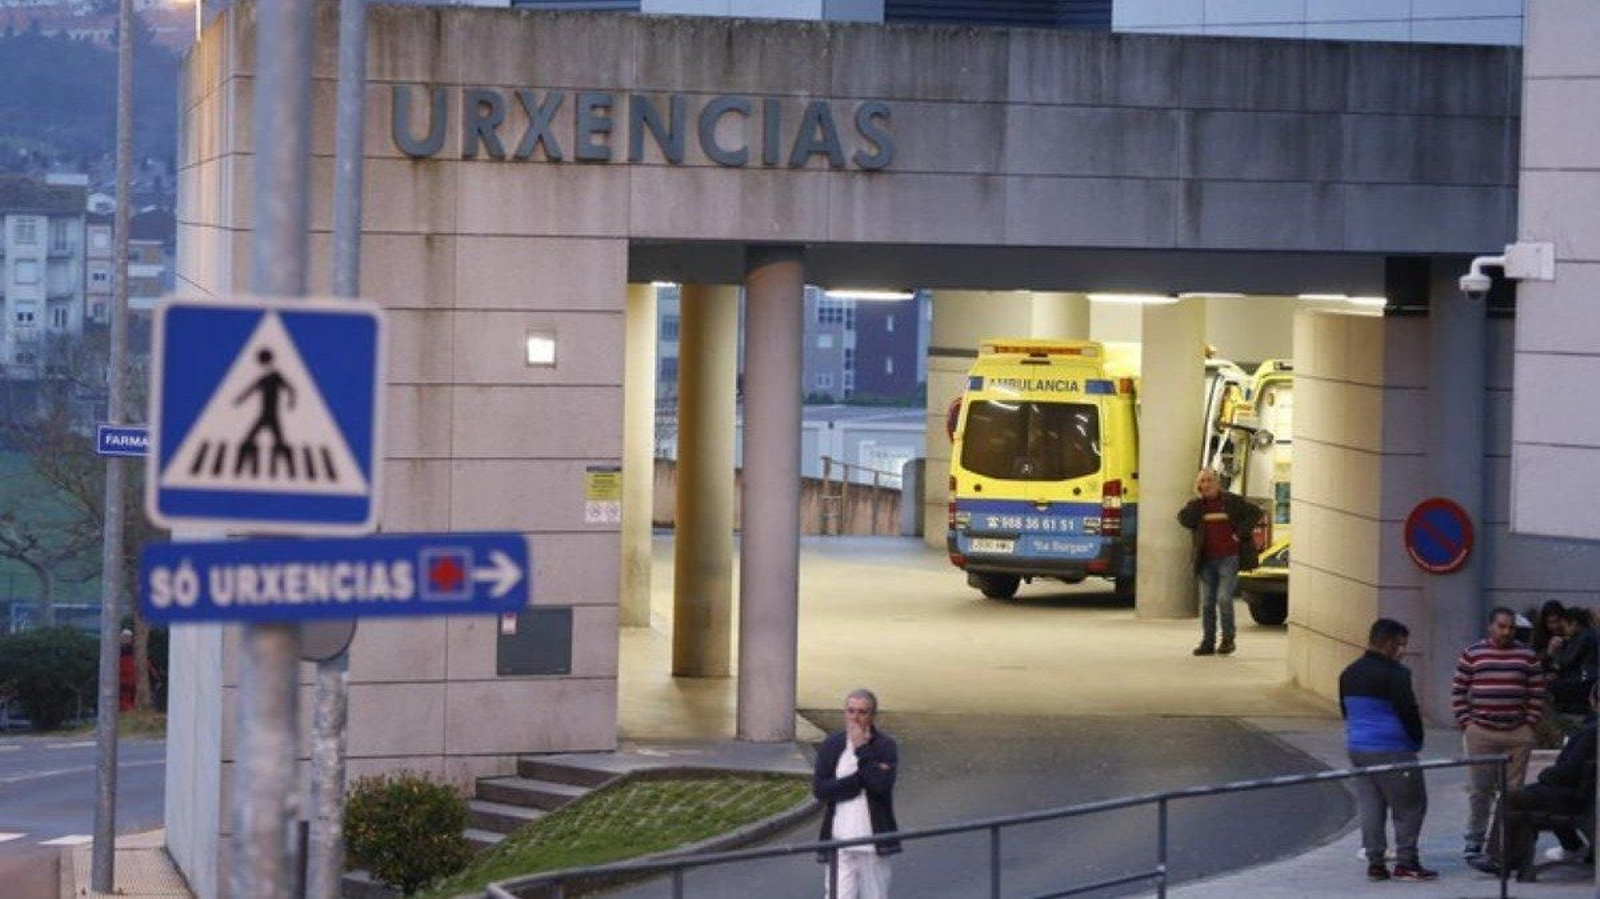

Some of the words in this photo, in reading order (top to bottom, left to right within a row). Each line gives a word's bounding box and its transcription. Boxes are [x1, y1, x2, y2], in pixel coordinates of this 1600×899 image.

[392, 84, 896, 171] URXENCIAS
[989, 378, 1078, 392] AMBULANCIA
[149, 558, 200, 608] SÓ
[208, 560, 415, 607] URXENCIAS
